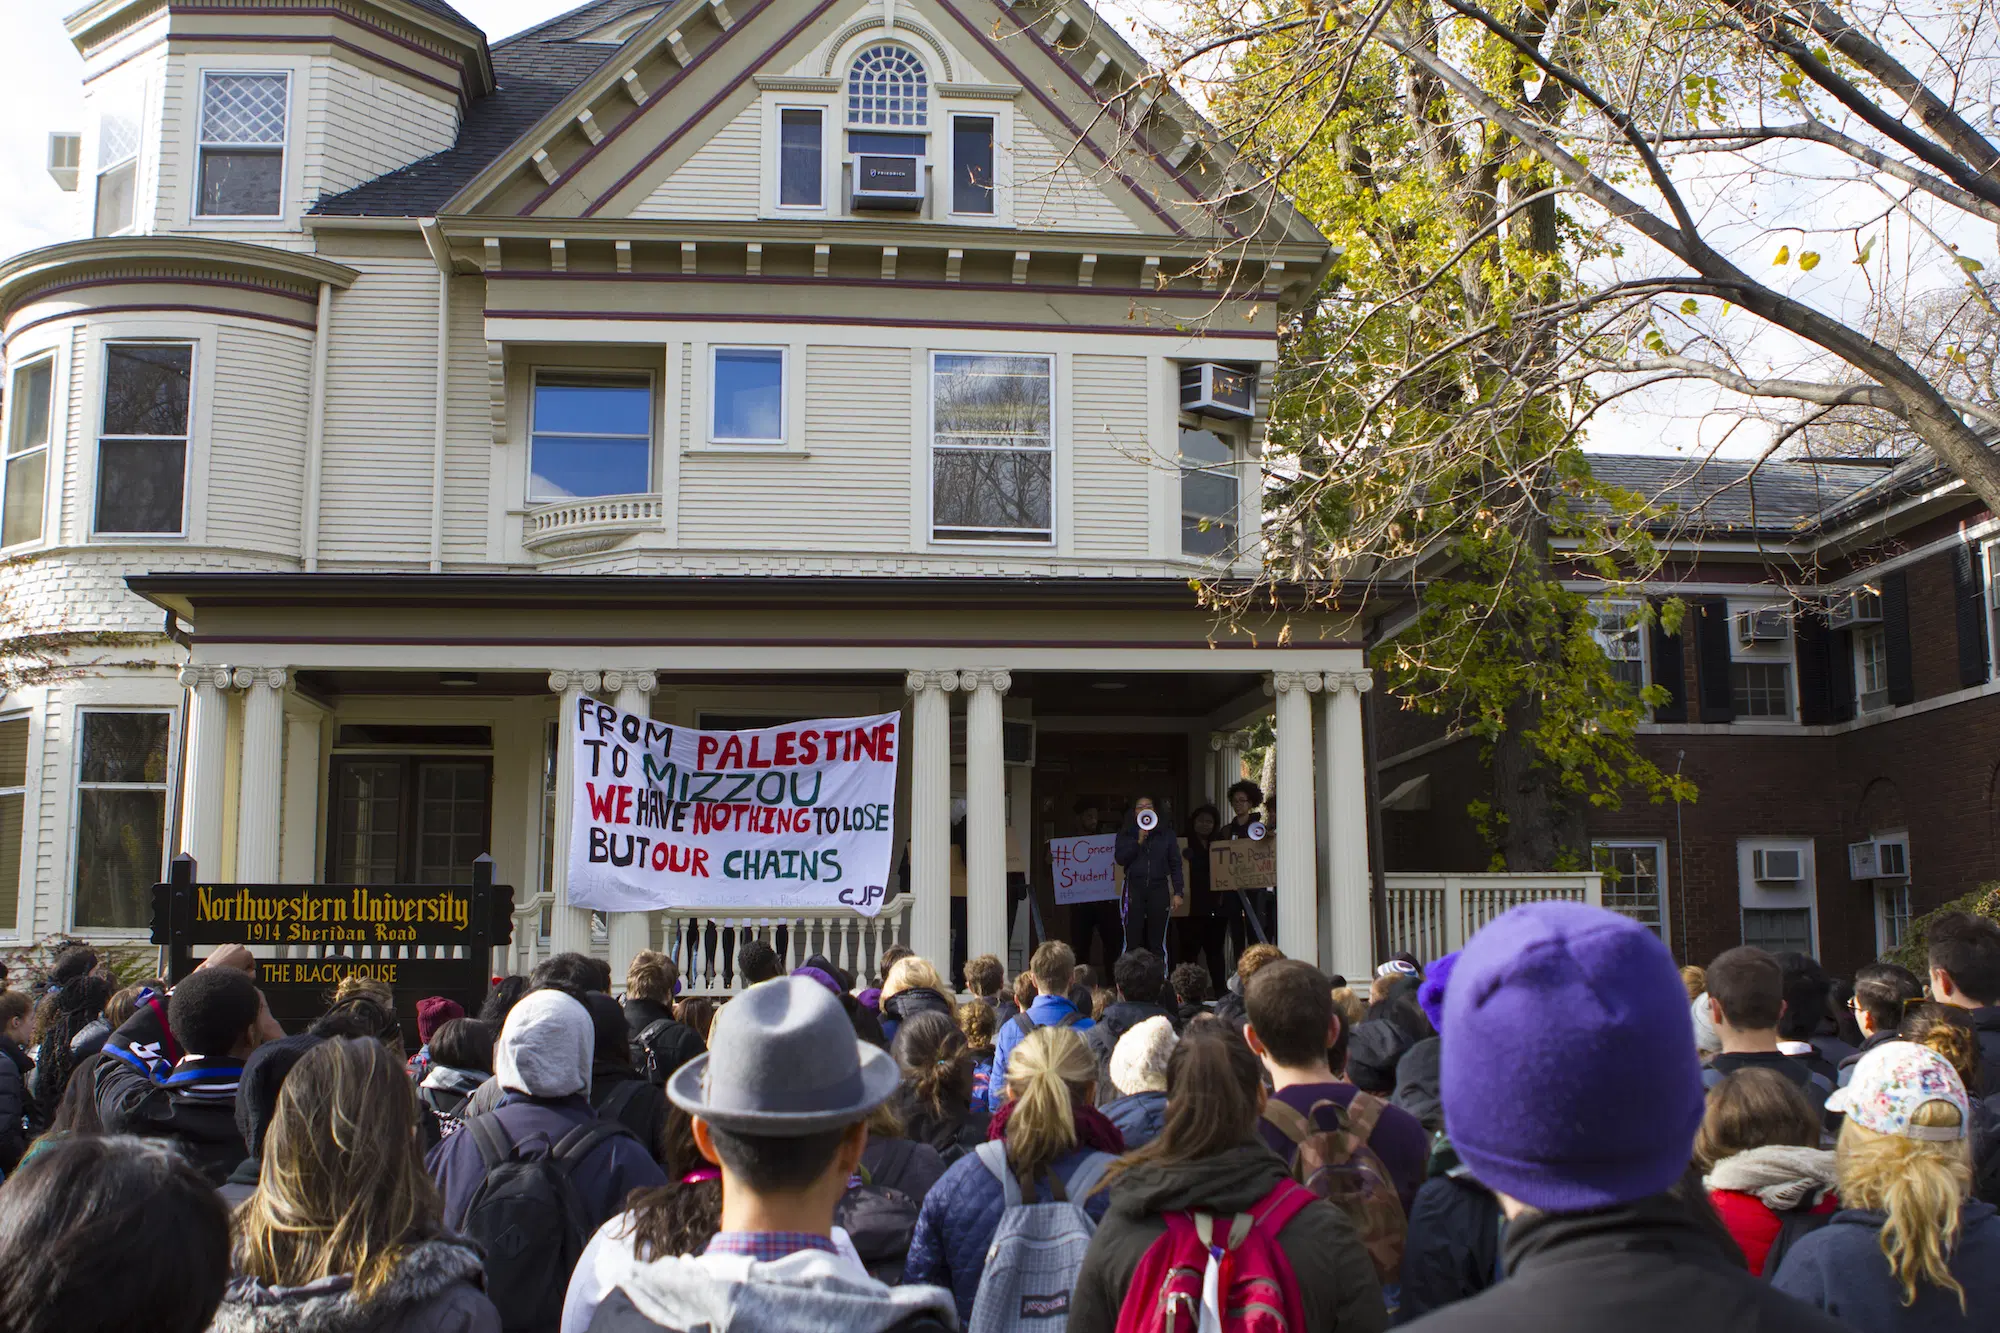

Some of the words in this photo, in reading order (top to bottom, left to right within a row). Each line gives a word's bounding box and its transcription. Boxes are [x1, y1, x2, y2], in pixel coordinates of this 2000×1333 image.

[578, 697, 674, 758] FROM
[697, 723, 895, 771] PALESTINE
[583, 739, 628, 778] TO
[643, 753, 823, 807] MIZZOU
[585, 782, 633, 824] WE
[636, 788, 691, 833] HAVE
[692, 802, 811, 836] NOTHING
[813, 806, 840, 835] TO
[843, 803, 889, 832] LOSE
[589, 827, 650, 869] BUT
[652, 842, 710, 878] OUR
[723, 849, 842, 883] CHAINS
[1211, 846, 1245, 865] The
[196, 886, 348, 922] Northwestern
[352, 888, 469, 931] University
[838, 885, 884, 906] CJP
[246, 923, 281, 941] 1914
[286, 922, 366, 942] Sheridan
[374, 923, 417, 941] Road
[262, 963, 291, 983] THE
[295, 963, 344, 983] BLACK
[346, 963, 398, 984] HOUSE
